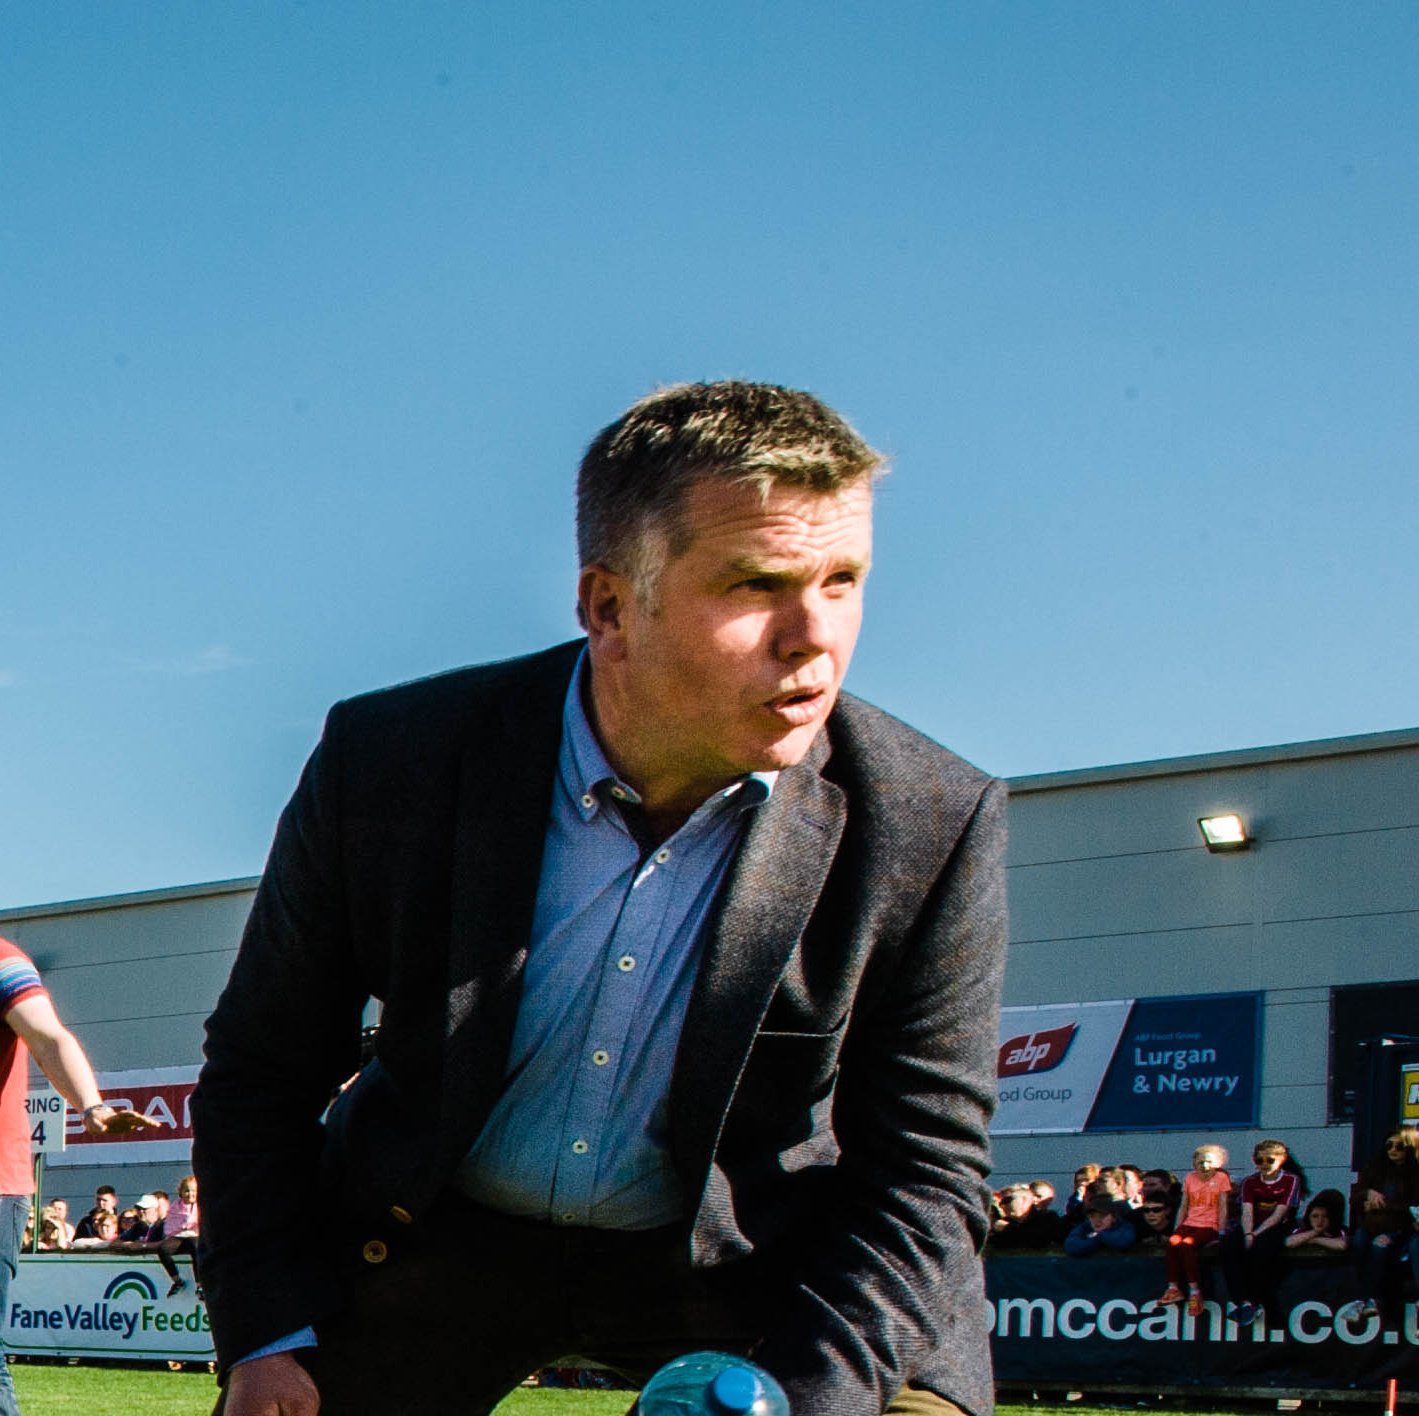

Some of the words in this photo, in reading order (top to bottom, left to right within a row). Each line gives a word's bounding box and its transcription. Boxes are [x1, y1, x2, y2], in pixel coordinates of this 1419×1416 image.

[1006, 1034, 1051, 1070] abp
[1135, 1048, 1216, 1070] Lurgan
[999, 1087, 1019, 1101] od
[1024, 1086, 1072, 1103] Group
[1133, 1075, 1150, 1093] &
[1158, 1073, 1238, 1096] Newry
[31, 1121, 46, 1145] 4
[142, 1304, 211, 1332] Feeds
